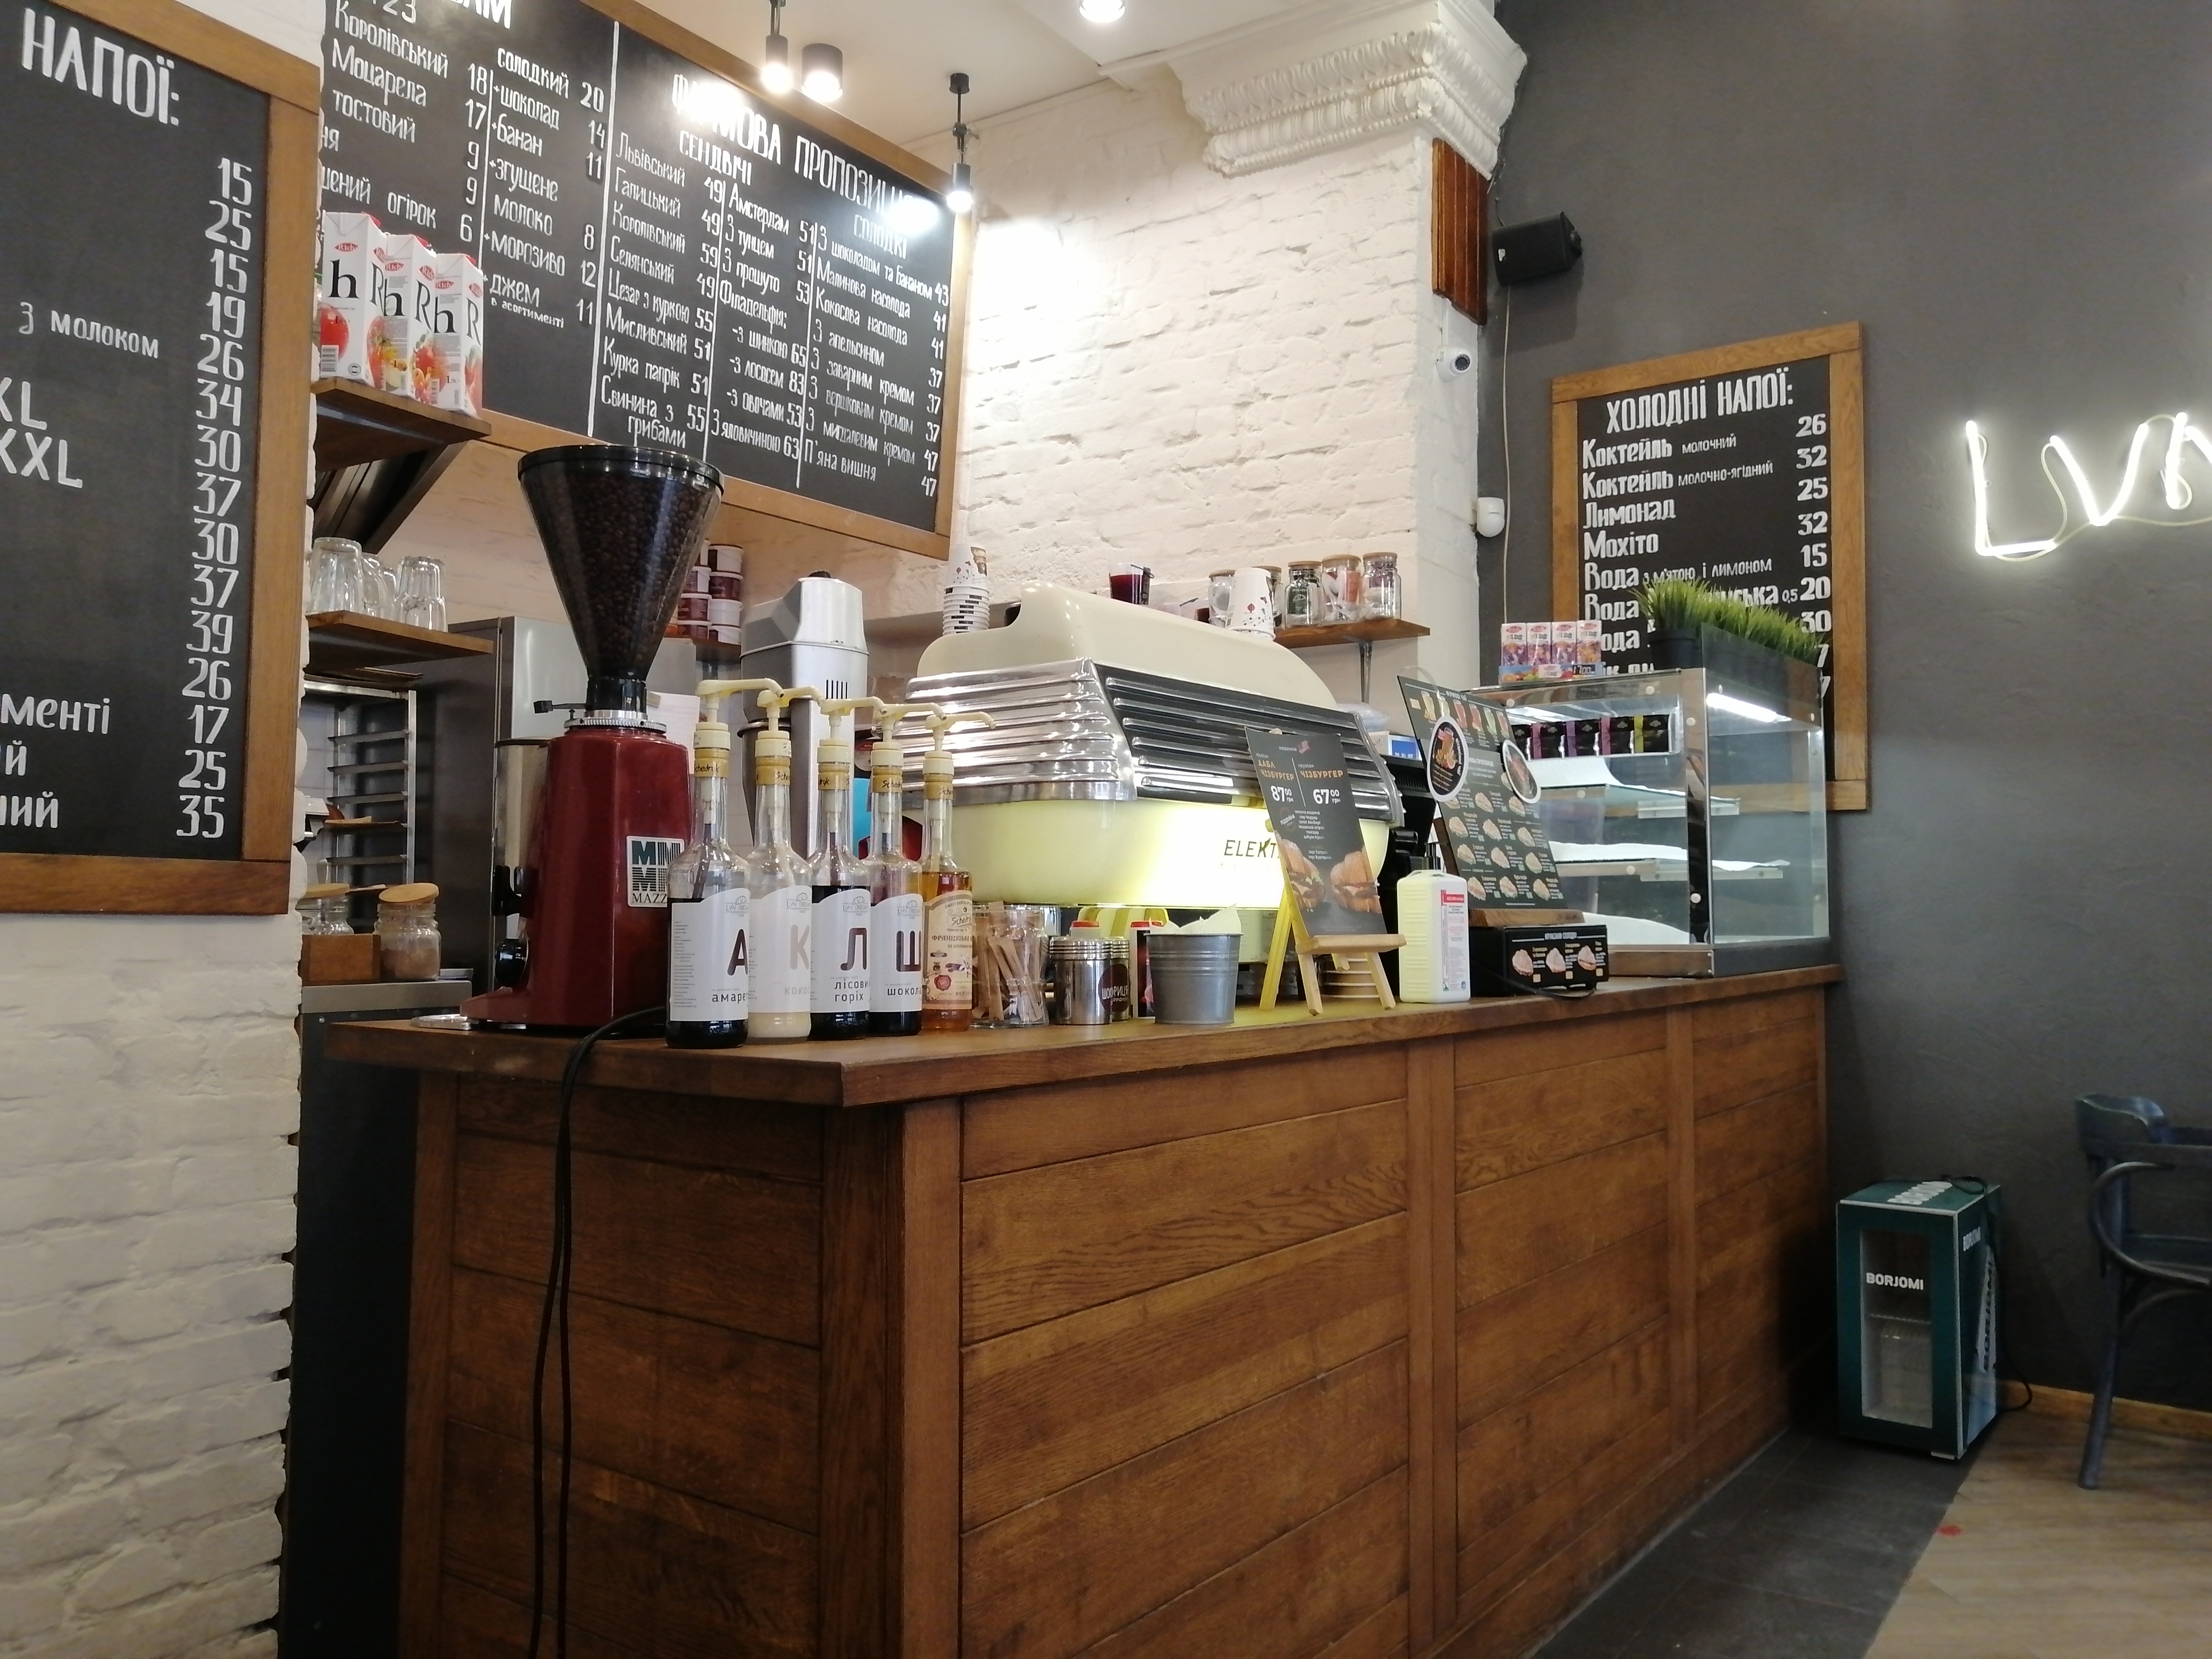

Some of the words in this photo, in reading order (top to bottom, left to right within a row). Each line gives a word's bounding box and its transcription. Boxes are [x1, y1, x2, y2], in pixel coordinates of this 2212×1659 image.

[21, 7, 180, 126] НАПОЇ:
[468, 63, 487, 95] 18
[332, 38, 427, 107] Моцарела
[465, 99, 487, 130] 17
[580, 82, 604, 113] 20
[588, 120, 605, 149] 14
[467, 141, 479, 170] 9
[586, 151, 602, 180] 11
[217, 157, 252, 206] 15
[465, 177, 478, 205] 9
[704, 177, 723, 203] 49
[205, 200, 252, 251] 25
[460, 214, 473, 242] 6
[701, 209, 721, 236] 49
[729, 182, 789, 235] Амстердам
[799, 220, 814, 245] 51
[584, 224, 595, 251] 8
[700, 243, 718, 268] 59
[797, 250, 812, 274] 51
[210, 249, 247, 294] 15
[580, 260, 596, 288] 12
[697, 273, 715, 299] 49
[796, 280, 810, 305] 53
[817, 256, 866, 300] Малинова
[933, 311, 947, 333] 41
[935, 282, 949, 306] 43
[206, 291, 245, 338] 19
[576, 298, 593, 325] 11
[695, 307, 713, 332] 55
[816, 286, 860, 326] Кокосова
[931, 337, 944, 360] 41
[197, 334, 244, 381] 26
[694, 338, 710, 361] 51
[791, 343, 806, 367] 65
[603, 336, 639, 379] Курка
[691, 373, 708, 396] 51
[928, 367, 942, 388] 37
[789, 371, 804, 395] 83
[195, 378, 241, 426] 34
[786, 402, 802, 428] 53
[926, 394, 941, 414] 37
[1607, 379, 1707, 433] ХОЛОДНІ
[687, 404, 706, 432] 55
[926, 421, 940, 443] 37
[194, 425, 240, 472] 30
[783, 435, 800, 460] 63
[1583, 437, 1672, 469] Коктейль
[1795, 413, 1826, 437] 26
[924, 449, 938, 472] 47
[1583, 469, 1673, 500] Коктейль
[1796, 445, 1827, 469] 32
[193, 472, 241, 517] 37
[921, 476, 937, 497] 47
[1583, 498, 1676, 529] Лимонад
[1797, 477, 1828, 502] 25
[192, 518, 239, 565] 30
[1584, 530, 1659, 560] Мохіто
[1798, 511, 1828, 536] 32
[1585, 562, 1639, 591] Вода
[1801, 543, 1827, 567] 15
[191, 564, 239, 608] 37
[1585, 593, 1639, 622] Вода
[1800, 576, 1831, 601] 20
[186, 610, 233, 654] 39
[1600, 629, 1640, 653] ода
[1801, 610, 1832, 633] 30
[182, 658, 231, 700] 26
[187, 705, 229, 744] 17
[179, 750, 227, 790] 25
[1300, 770, 1343, 778] ЧІЗБУРГЕР
[176, 795, 225, 838] 35
[1224, 837, 1279, 858] ELEKT
[835, 991, 864, 1004] горіх
[1866, 1272, 1924, 1290] BORJOMI
